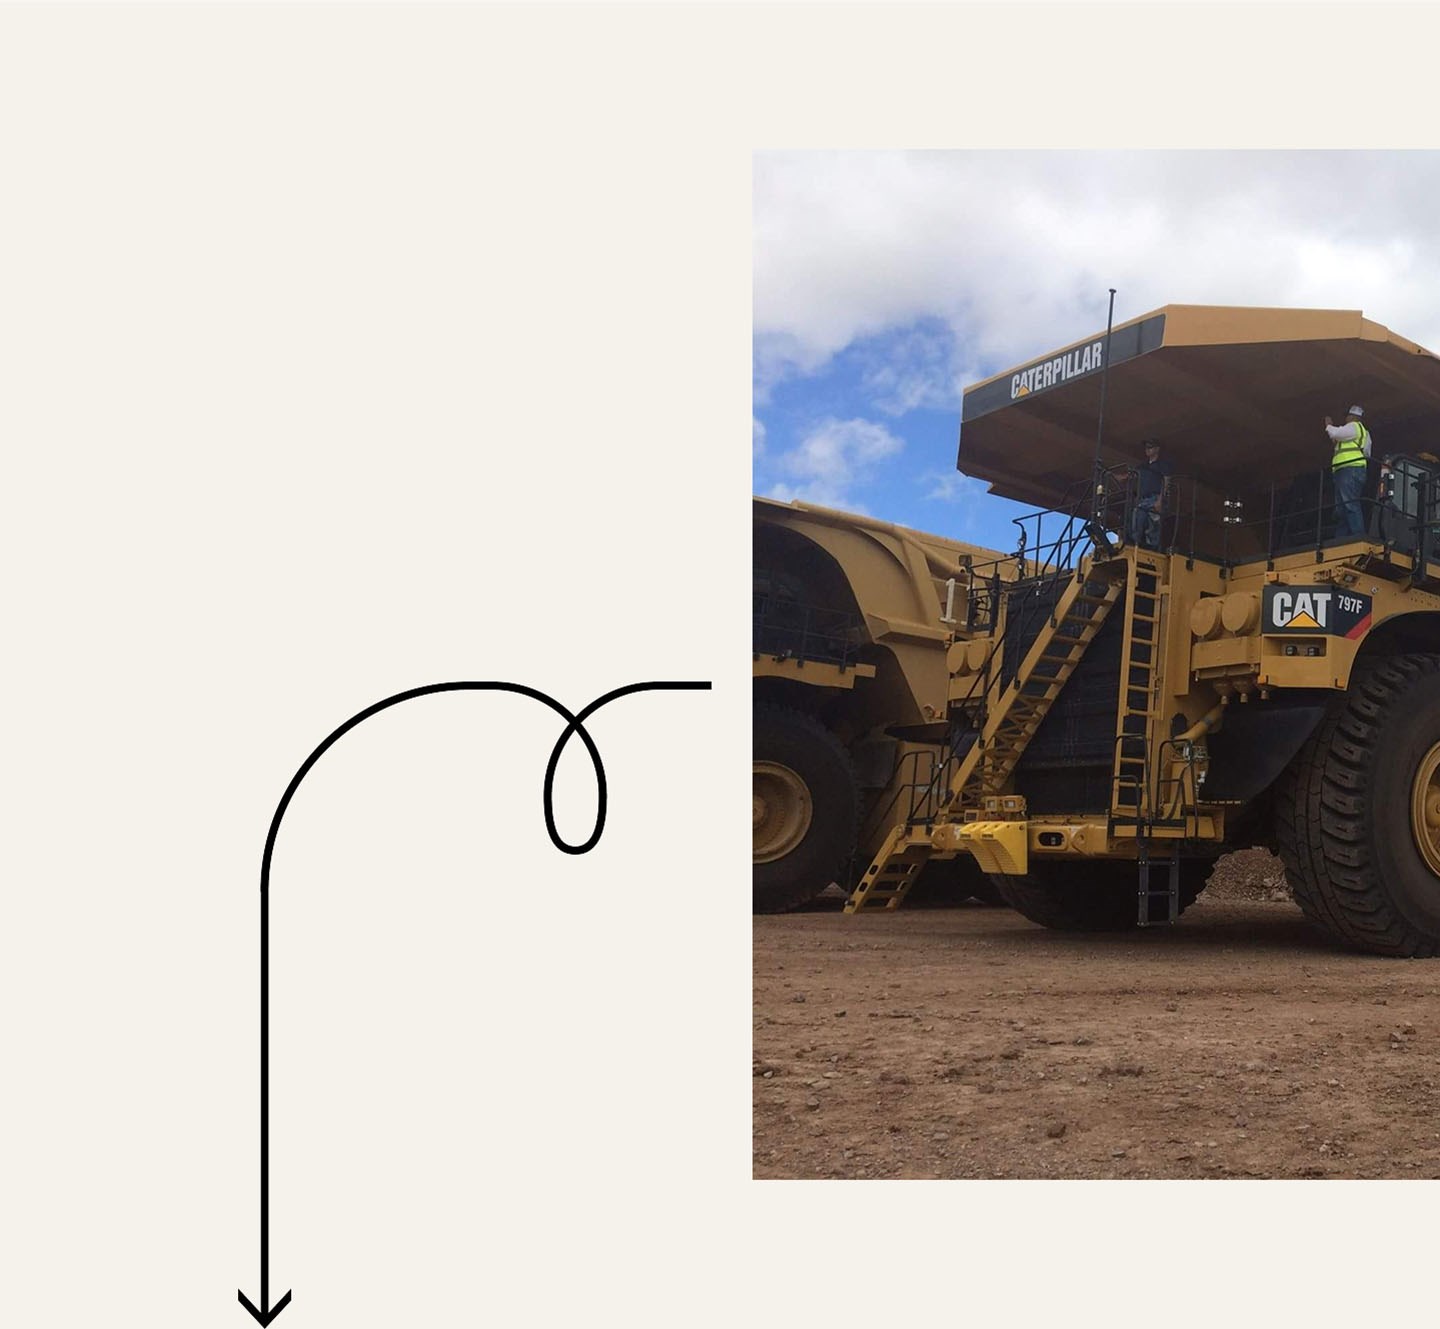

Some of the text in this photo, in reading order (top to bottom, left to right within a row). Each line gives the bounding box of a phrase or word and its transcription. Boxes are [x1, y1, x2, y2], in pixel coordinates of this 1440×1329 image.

[1010, 341, 1102, 399] CATERPILLAR
[1272, 592, 1363, 627] CAT 797F
